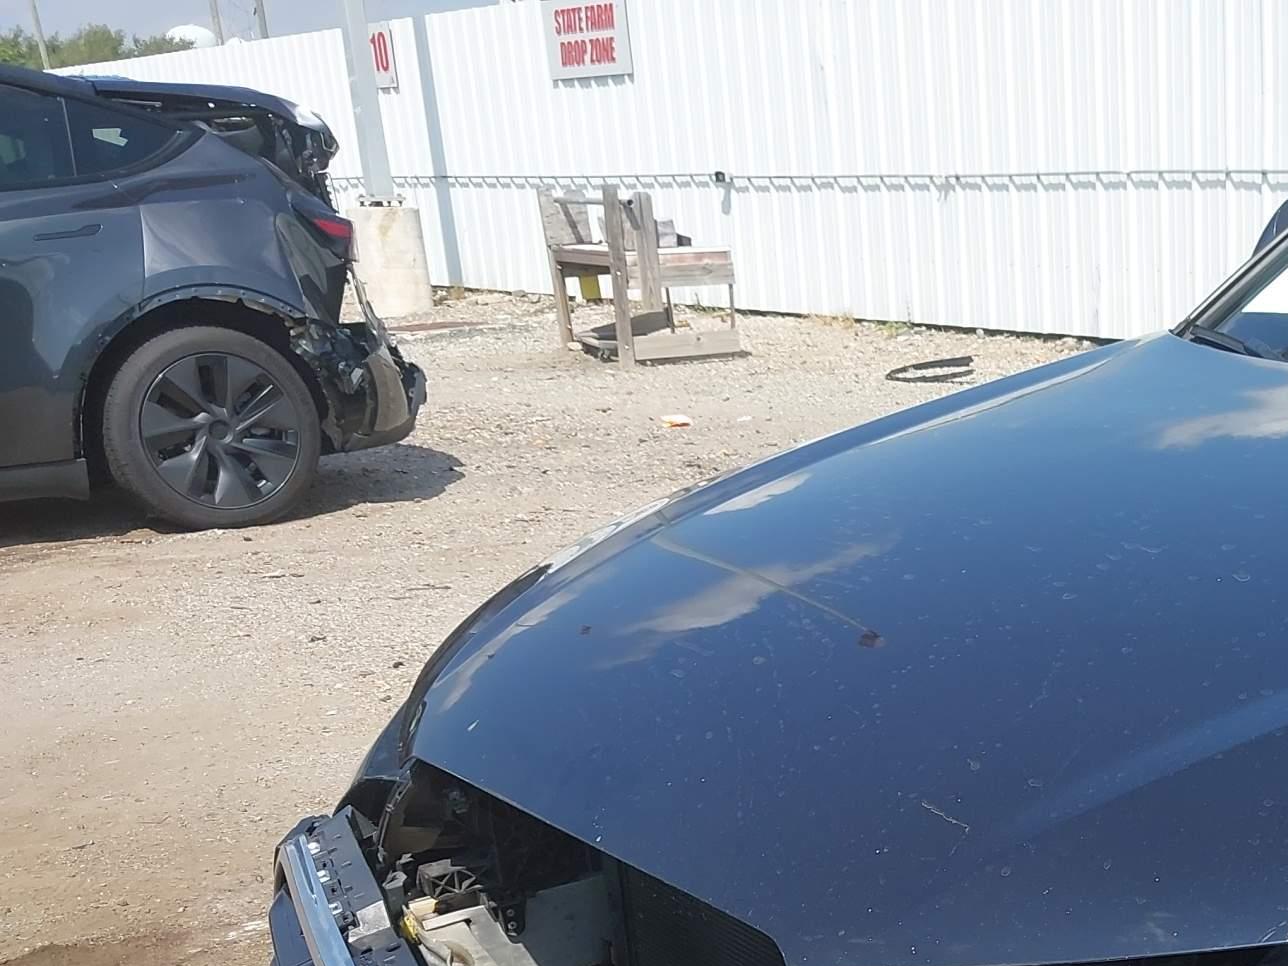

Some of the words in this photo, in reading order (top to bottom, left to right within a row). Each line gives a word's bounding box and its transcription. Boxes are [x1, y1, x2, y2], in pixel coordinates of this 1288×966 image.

[554, 7, 584, 36] STATE
[584, 3, 615, 32] FARM
[369, 32, 389, 72] 10
[560, 40, 587, 67] DROP
[589, 36, 616, 65] ZONE
